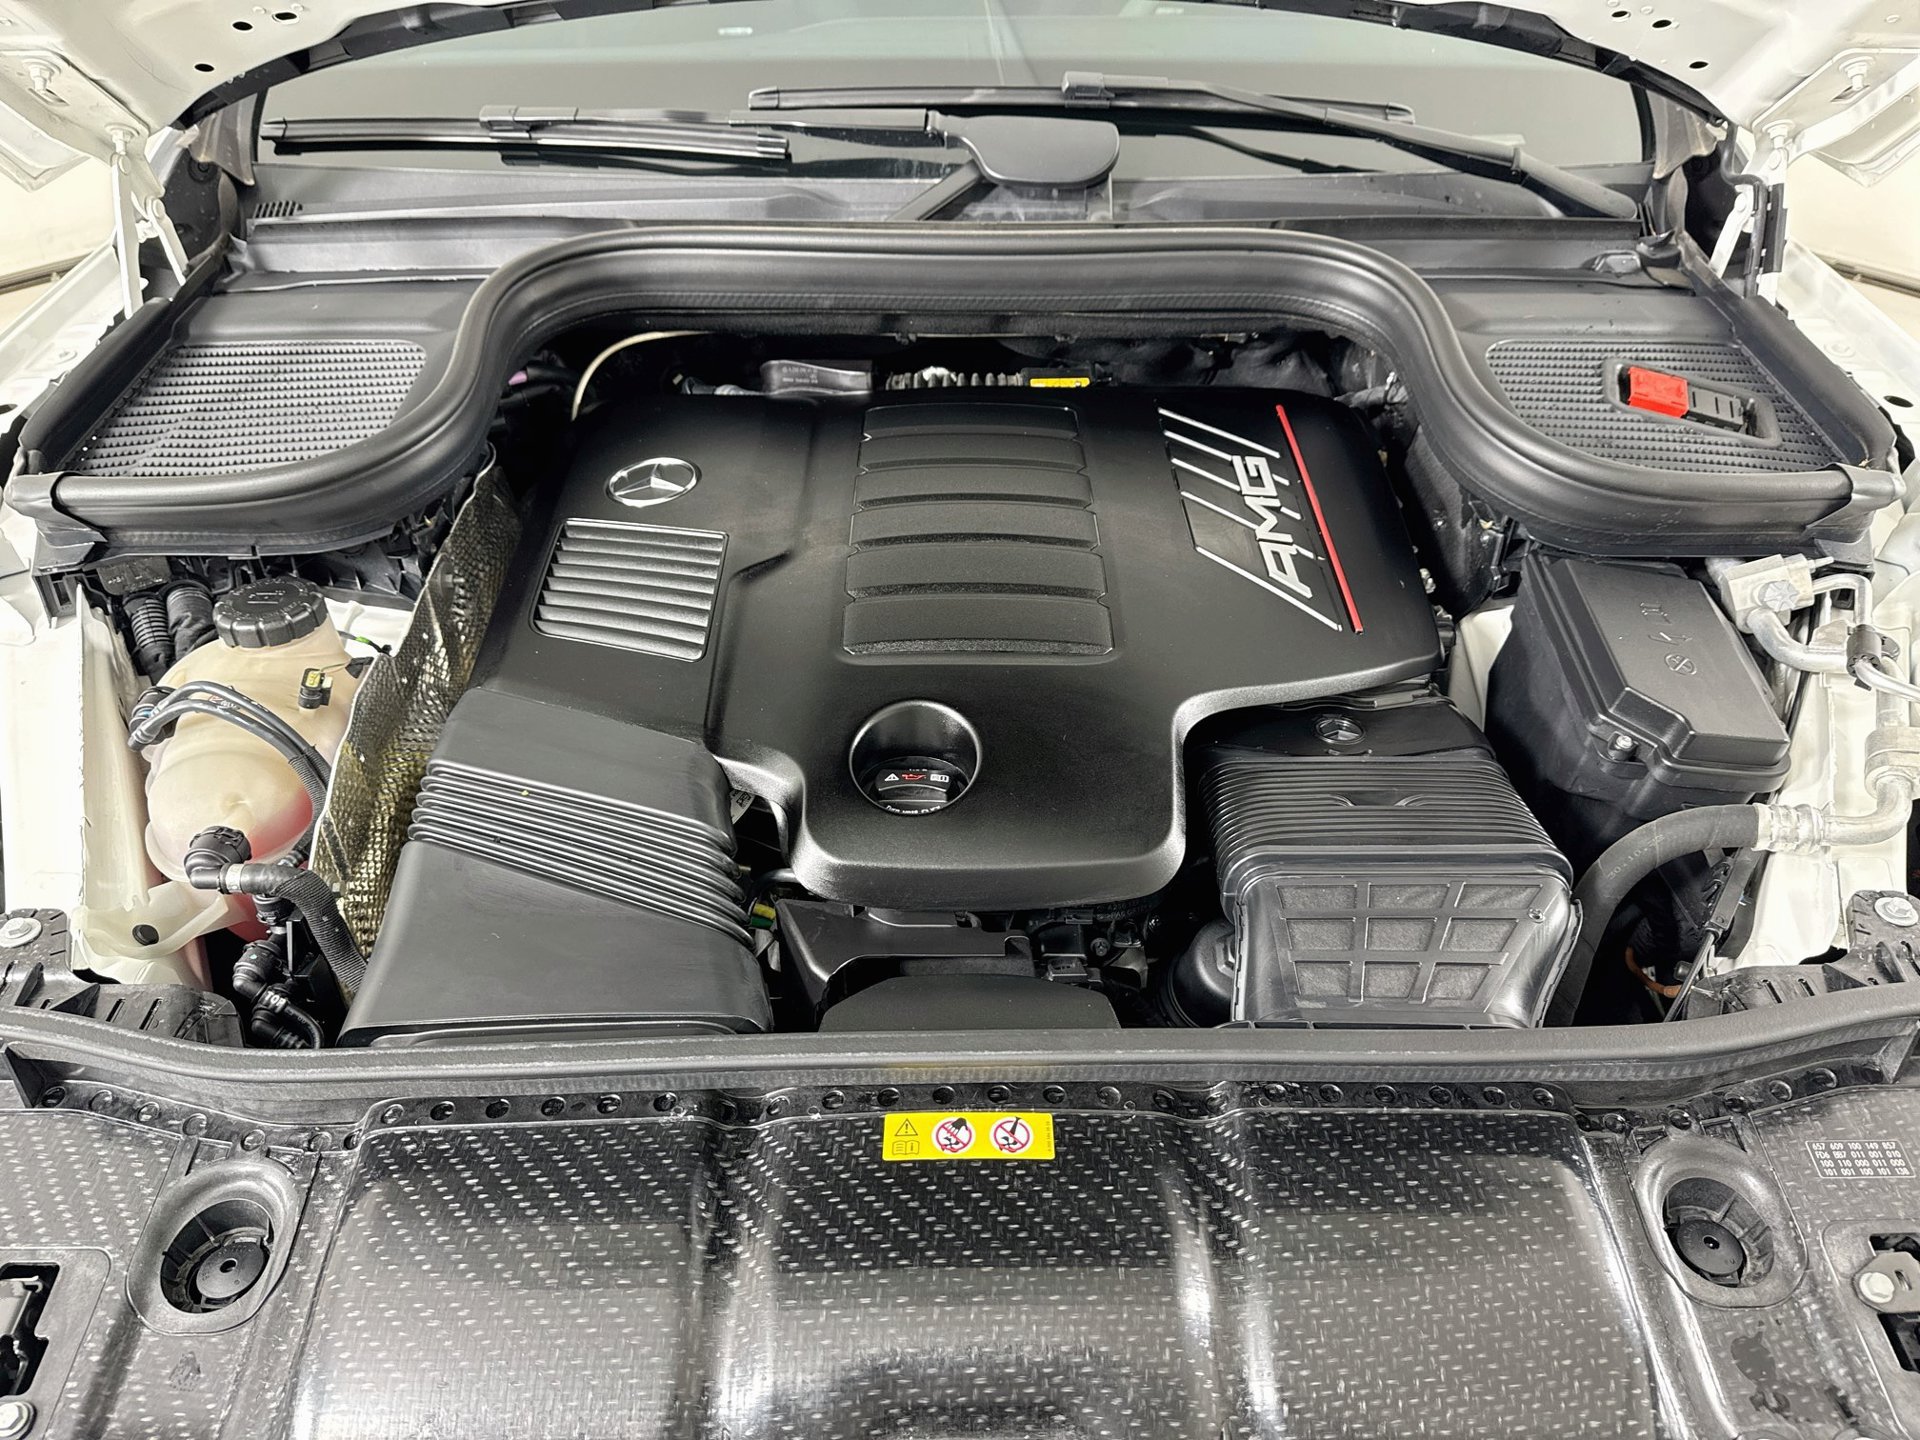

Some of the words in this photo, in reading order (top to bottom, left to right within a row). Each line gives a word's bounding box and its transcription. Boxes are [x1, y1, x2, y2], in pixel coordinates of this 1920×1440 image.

[1231, 455, 1313, 598] AMG
[264, 990, 287, 1008] TOP
[1847, 1142, 1862, 1150] 100
[1865, 1142, 1879, 1150] 149
[1850, 1150, 1865, 1158] 011
[1868, 1150, 1883, 1158] 001
[1886, 1150, 1902, 1158] 010
[1819, 1159, 1835, 1167] 100
[1837, 1159, 1852, 1167] 110
[1854, 1159, 1870, 1167] 000
[1872, 1159, 1887, 1167] 011
[1889, 1158, 1906, 1167] 000
[1823, 1168, 1838, 1176] 101
[1840, 1168, 1856, 1176] 001
[1859, 1168, 1874, 1176] 100
[1876, 1167, 1892, 1176] 101
